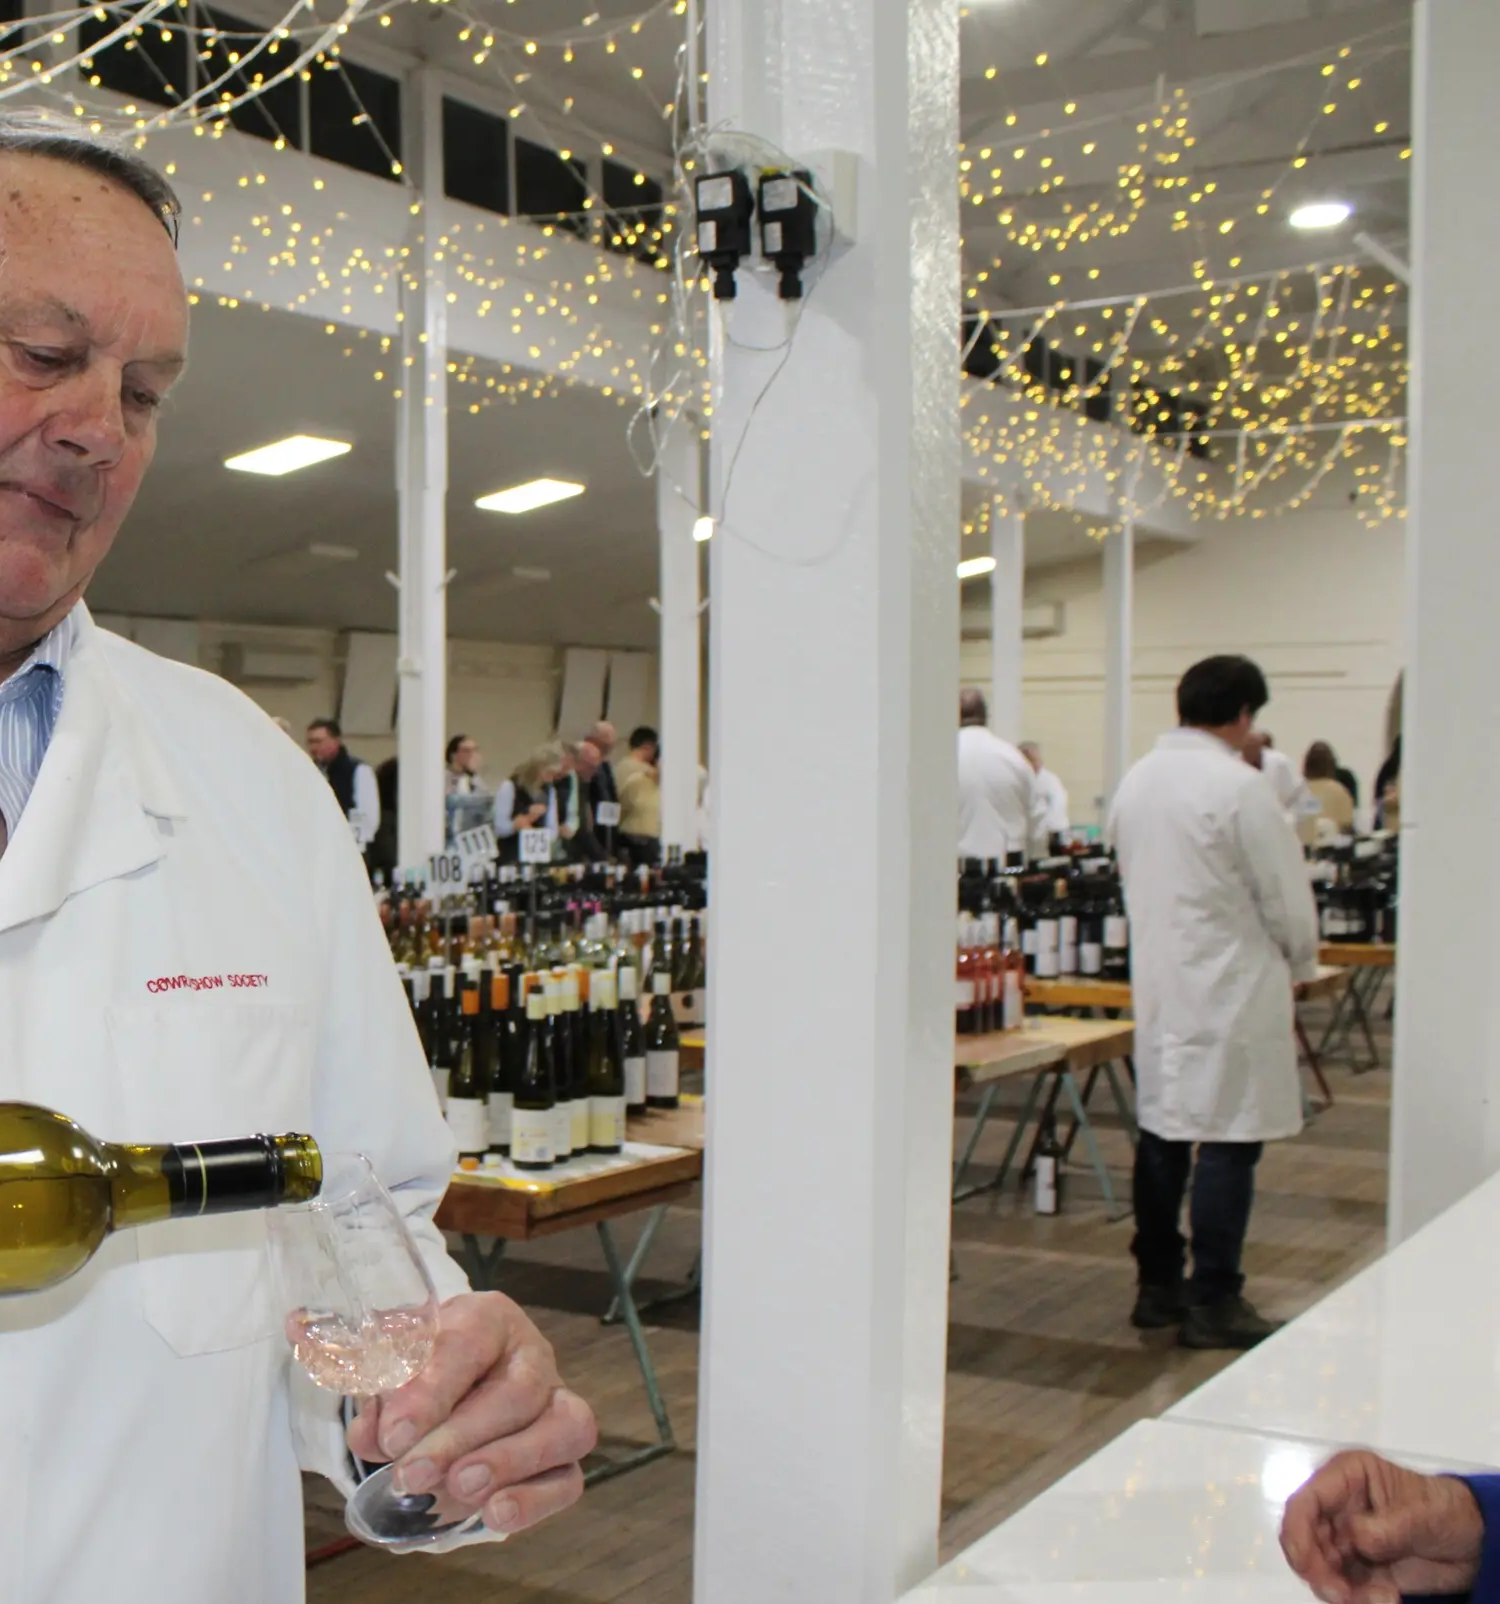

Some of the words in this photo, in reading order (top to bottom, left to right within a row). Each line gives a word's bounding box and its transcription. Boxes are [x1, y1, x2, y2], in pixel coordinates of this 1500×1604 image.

[462, 829, 492, 855] 111
[429, 855, 462, 883] 108
[147, 975, 190, 993] COWR
[191, 976, 223, 991] SHOW
[227, 974, 268, 987] SOCIETY
